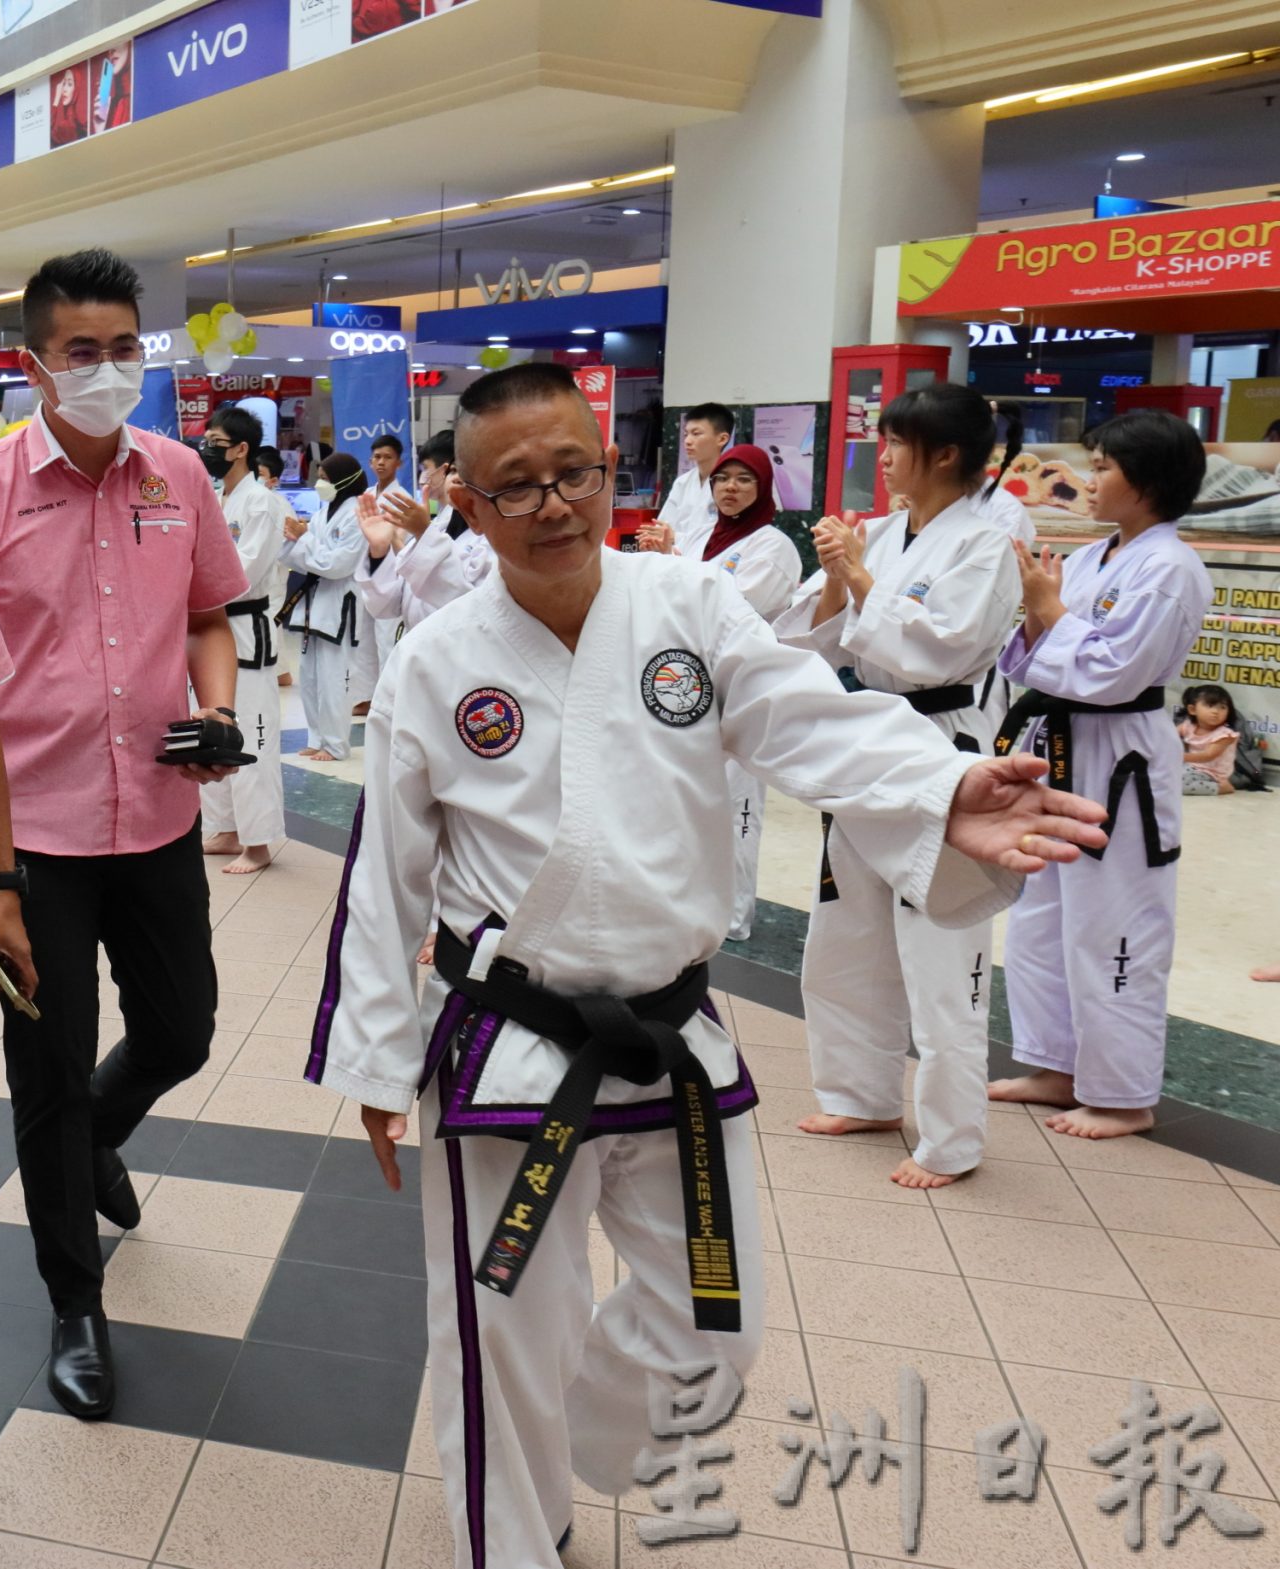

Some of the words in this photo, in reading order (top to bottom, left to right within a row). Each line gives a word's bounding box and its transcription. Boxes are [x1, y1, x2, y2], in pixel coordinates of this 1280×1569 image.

[167, 22, 248, 78] vivo
[996, 239, 1098, 277] Agro
[1106, 219, 1280, 262] Bazaar
[1135, 250, 1273, 278] K-SHOPPE
[474, 256, 594, 305] vivo
[332, 309, 384, 328] vivo
[330, 330, 407, 356] oppo
[643, 654, 669, 706] PERSEKUTUAN
[696, 684, 712, 713] GLOBAL
[256, 713, 266, 751] ITF
[658, 708, 693, 724] MALAYSIA
[740, 798, 751, 840] ITF
[969, 951, 984, 1012] ITF
[1113, 936, 1131, 994] ITF
[683, 1082, 707, 1133] MASTER
[695, 1170, 712, 1202] KEE
[697, 1203, 715, 1238] WAH
